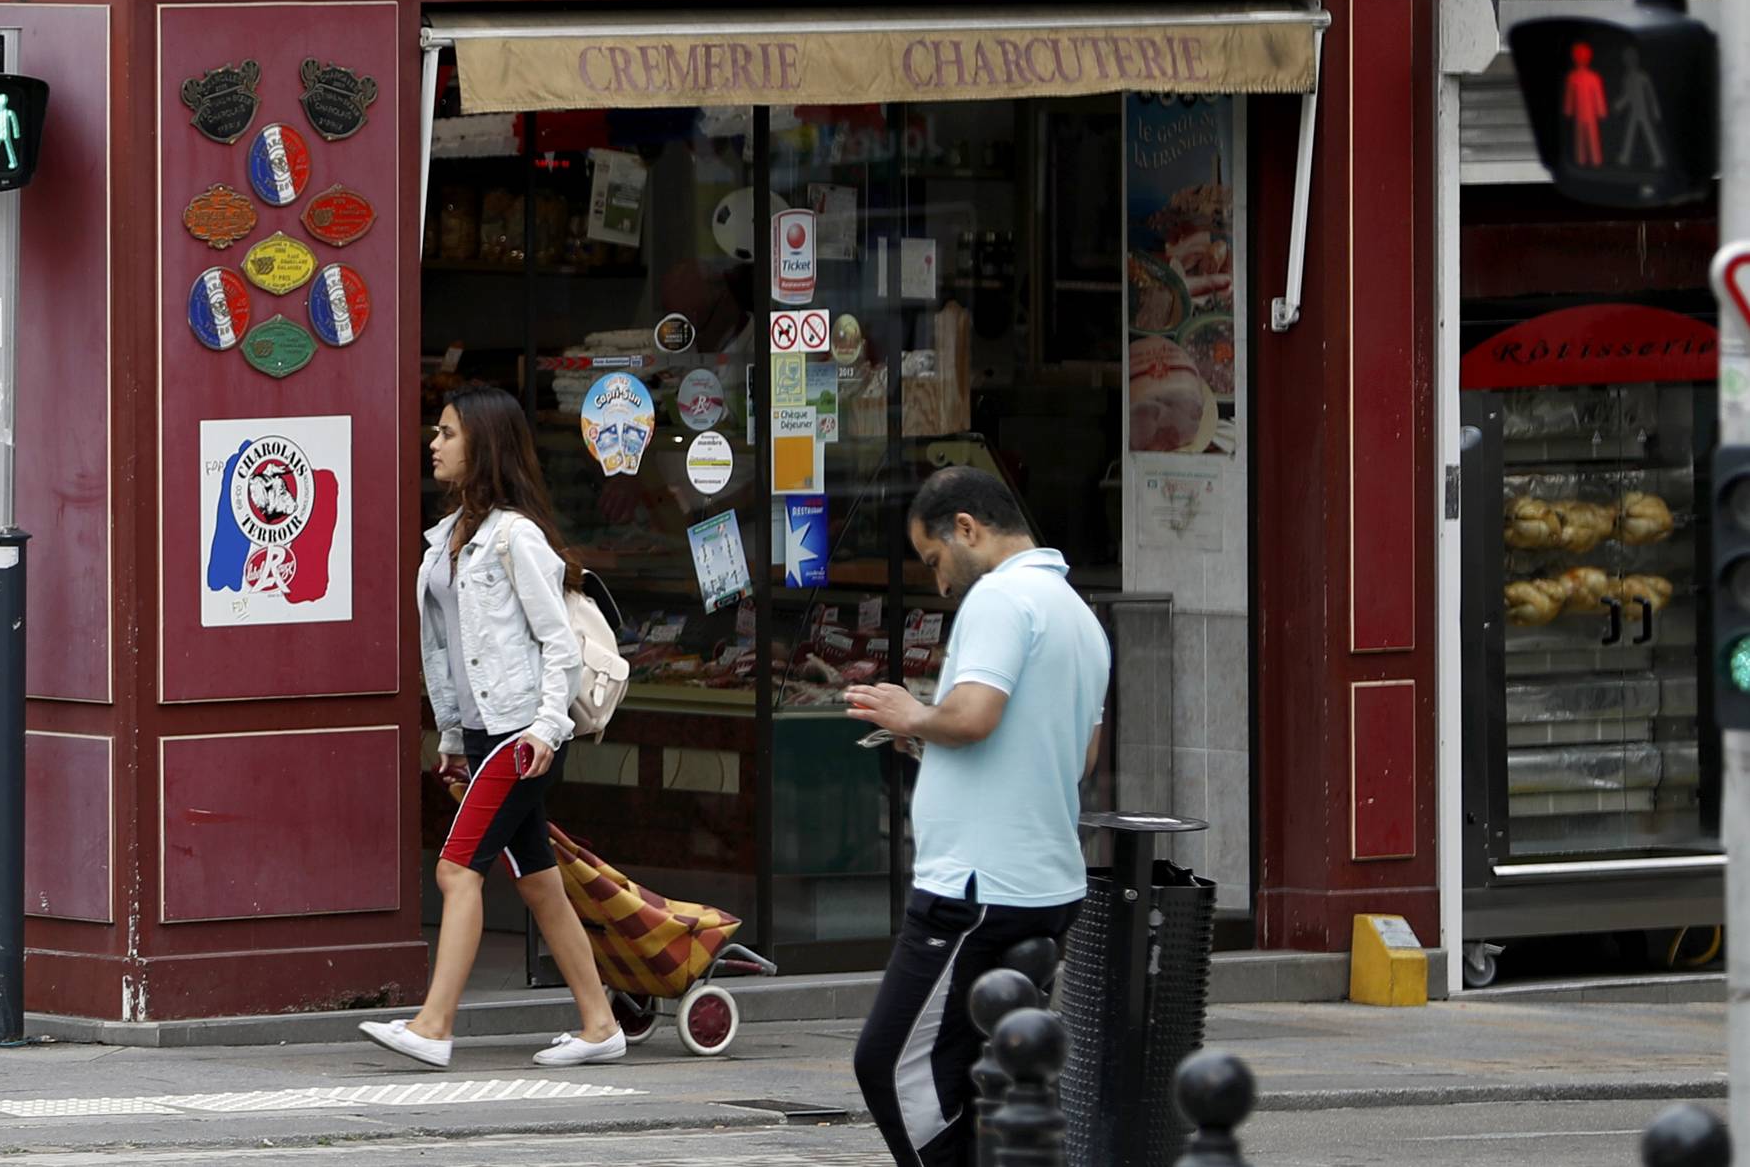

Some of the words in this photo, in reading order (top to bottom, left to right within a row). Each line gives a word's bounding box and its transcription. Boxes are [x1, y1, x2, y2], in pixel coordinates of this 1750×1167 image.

[578, 41, 802, 94] CREMERIE
[902, 34, 1210, 90] CHARCUTERIE
[782, 259, 811, 272] Ticket
[594, 386, 643, 409] Capri-Sun
[238, 440, 308, 480] CHAROLAIS
[241, 514, 304, 544] TERROIR
